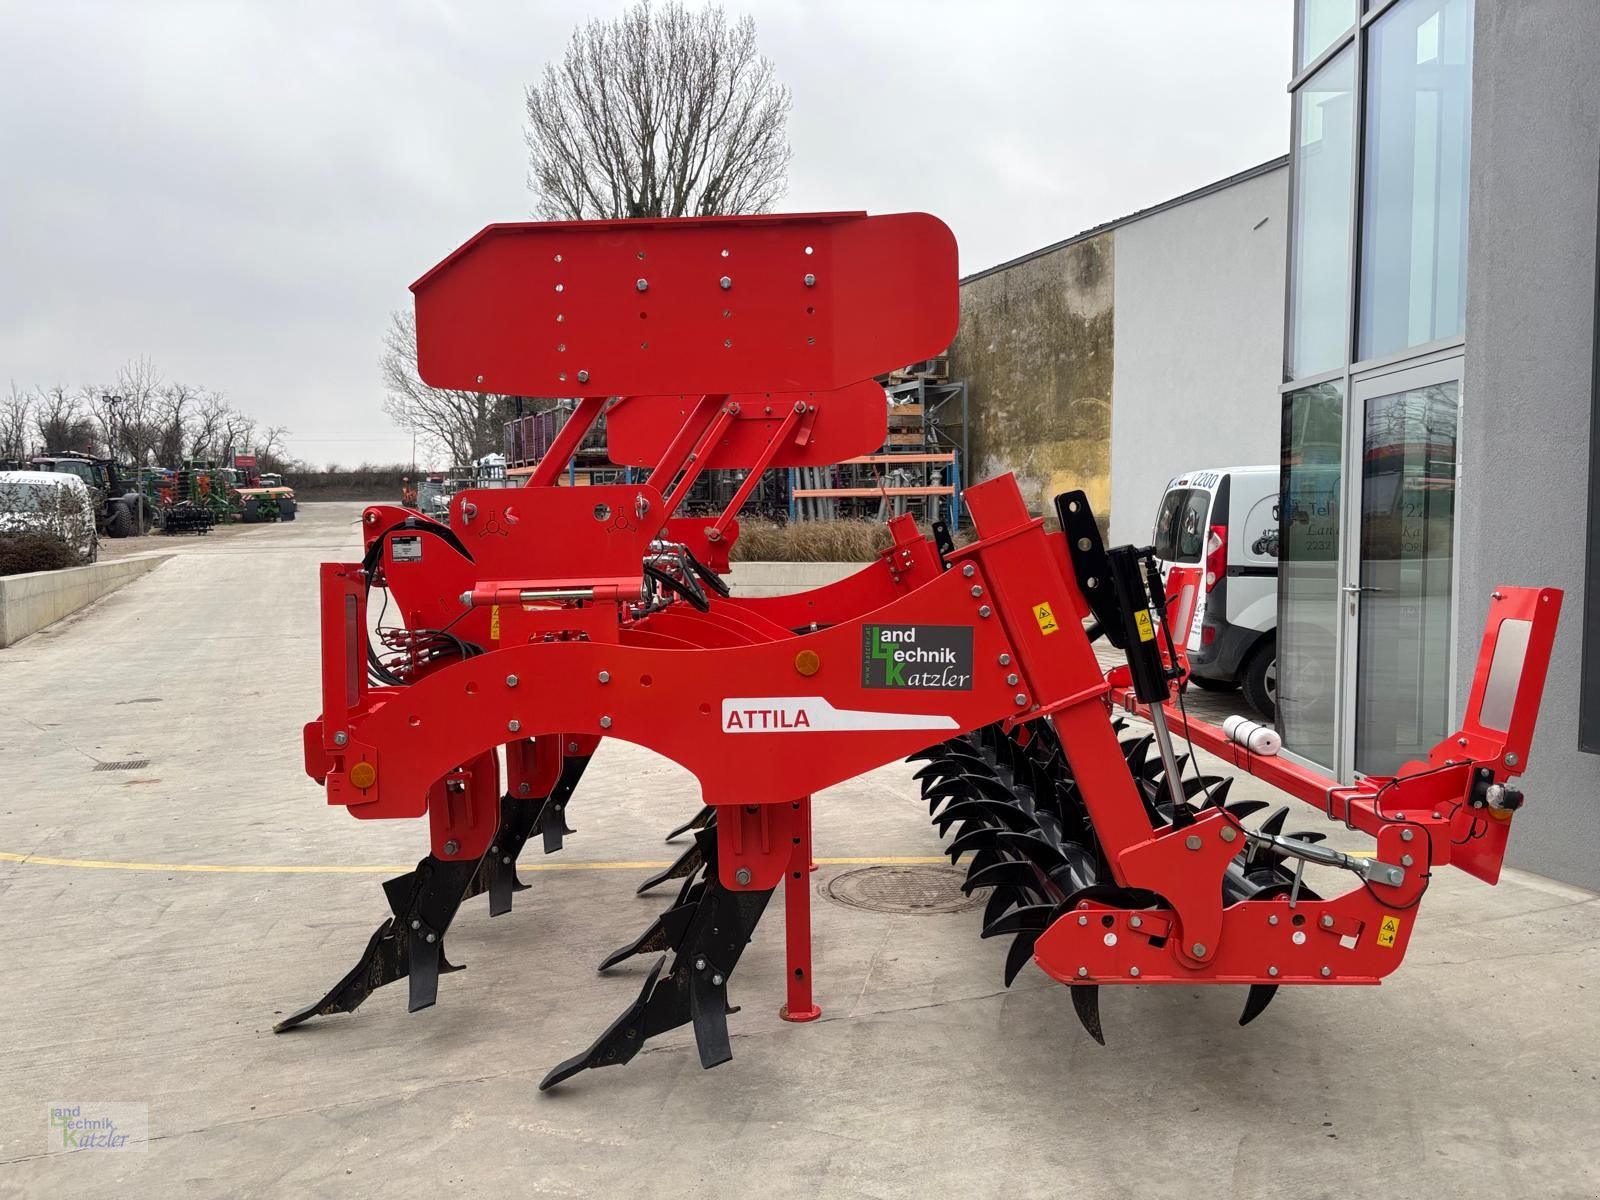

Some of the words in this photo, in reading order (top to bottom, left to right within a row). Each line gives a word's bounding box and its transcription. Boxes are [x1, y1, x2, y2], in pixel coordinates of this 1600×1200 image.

[872, 626, 915, 658] Land
[881, 643, 956, 664] Technik
[886, 663, 970, 687] Katzler
[726, 709, 811, 729] ATTILA
